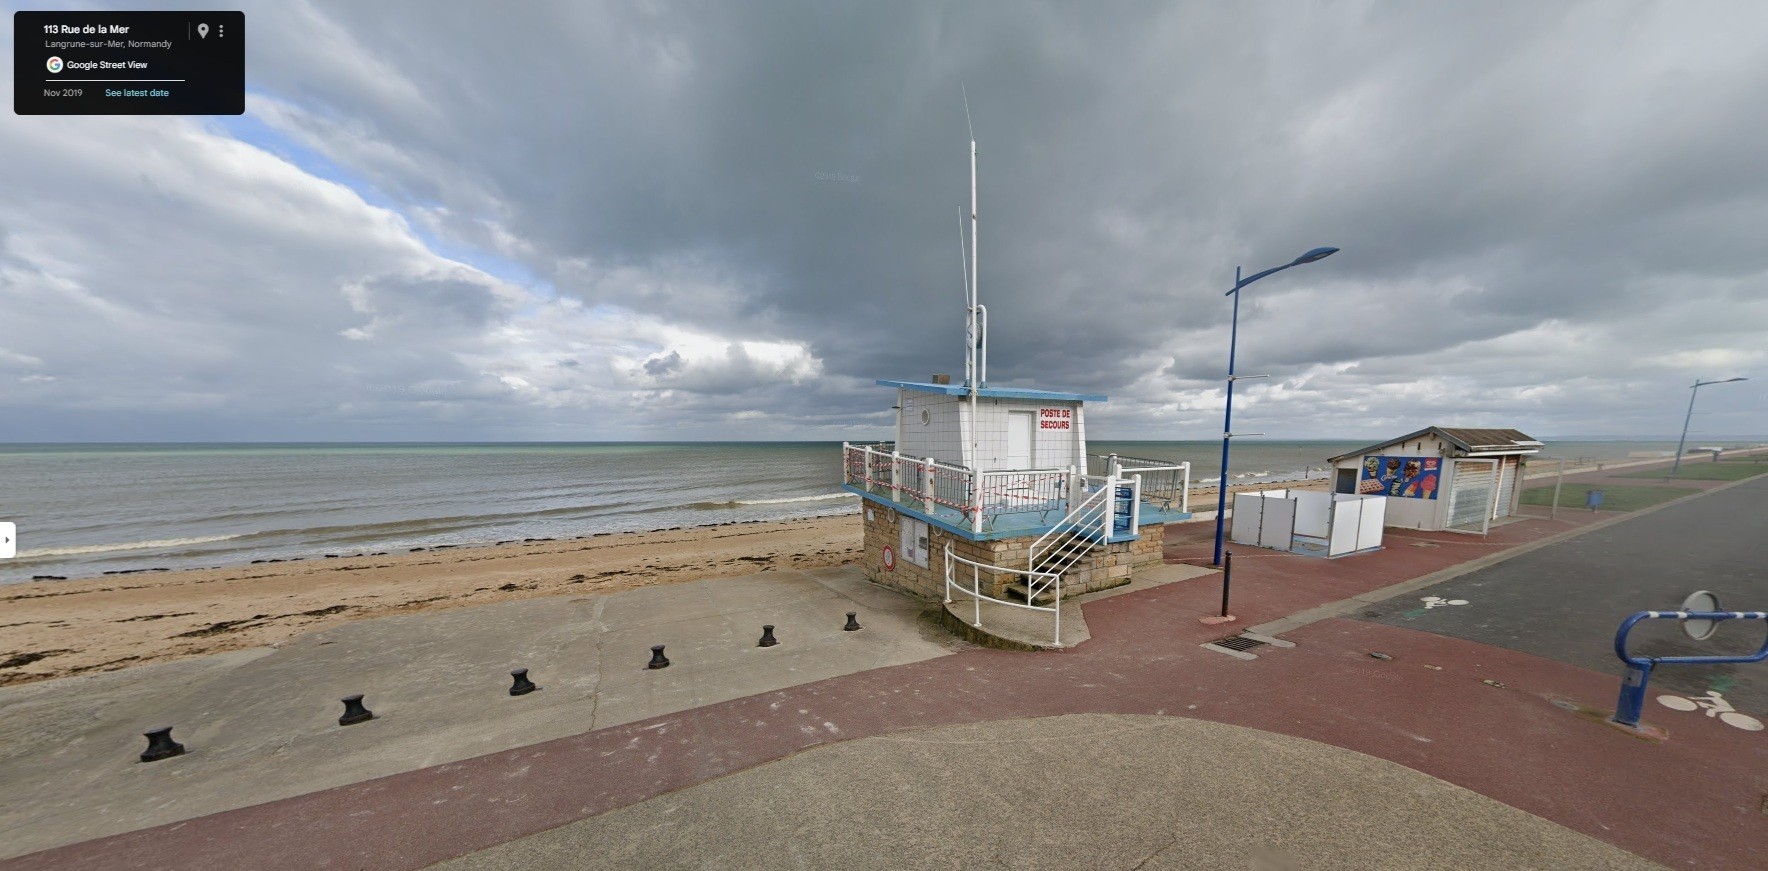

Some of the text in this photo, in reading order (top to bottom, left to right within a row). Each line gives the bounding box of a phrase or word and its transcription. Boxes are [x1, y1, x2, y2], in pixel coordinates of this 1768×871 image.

[1041, 409, 1070, 418] POSTE DE
[1041, 420, 1069, 429] SECOURS
